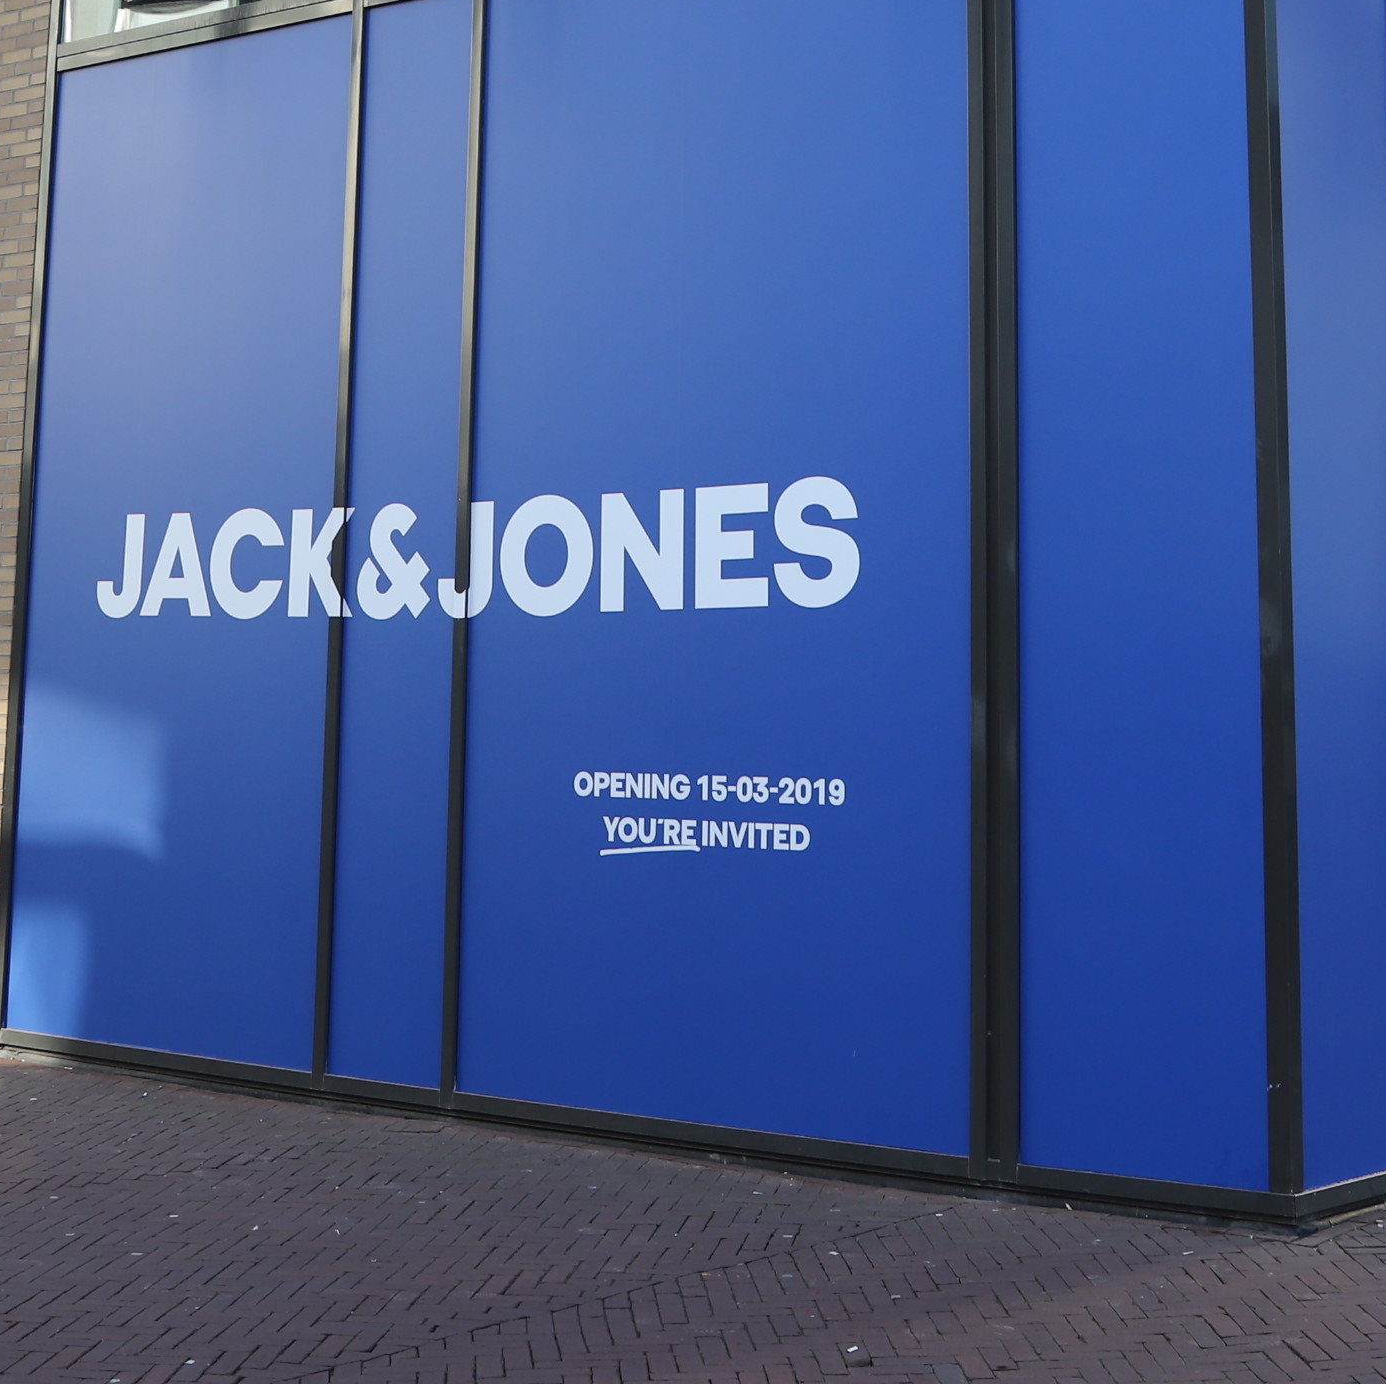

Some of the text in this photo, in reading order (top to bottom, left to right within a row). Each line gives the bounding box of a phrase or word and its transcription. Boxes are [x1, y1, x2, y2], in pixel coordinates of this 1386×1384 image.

[573, 771, 846, 806] OPENING 15-03-2019
[602, 816, 811, 851] YOU'RE INVITED
